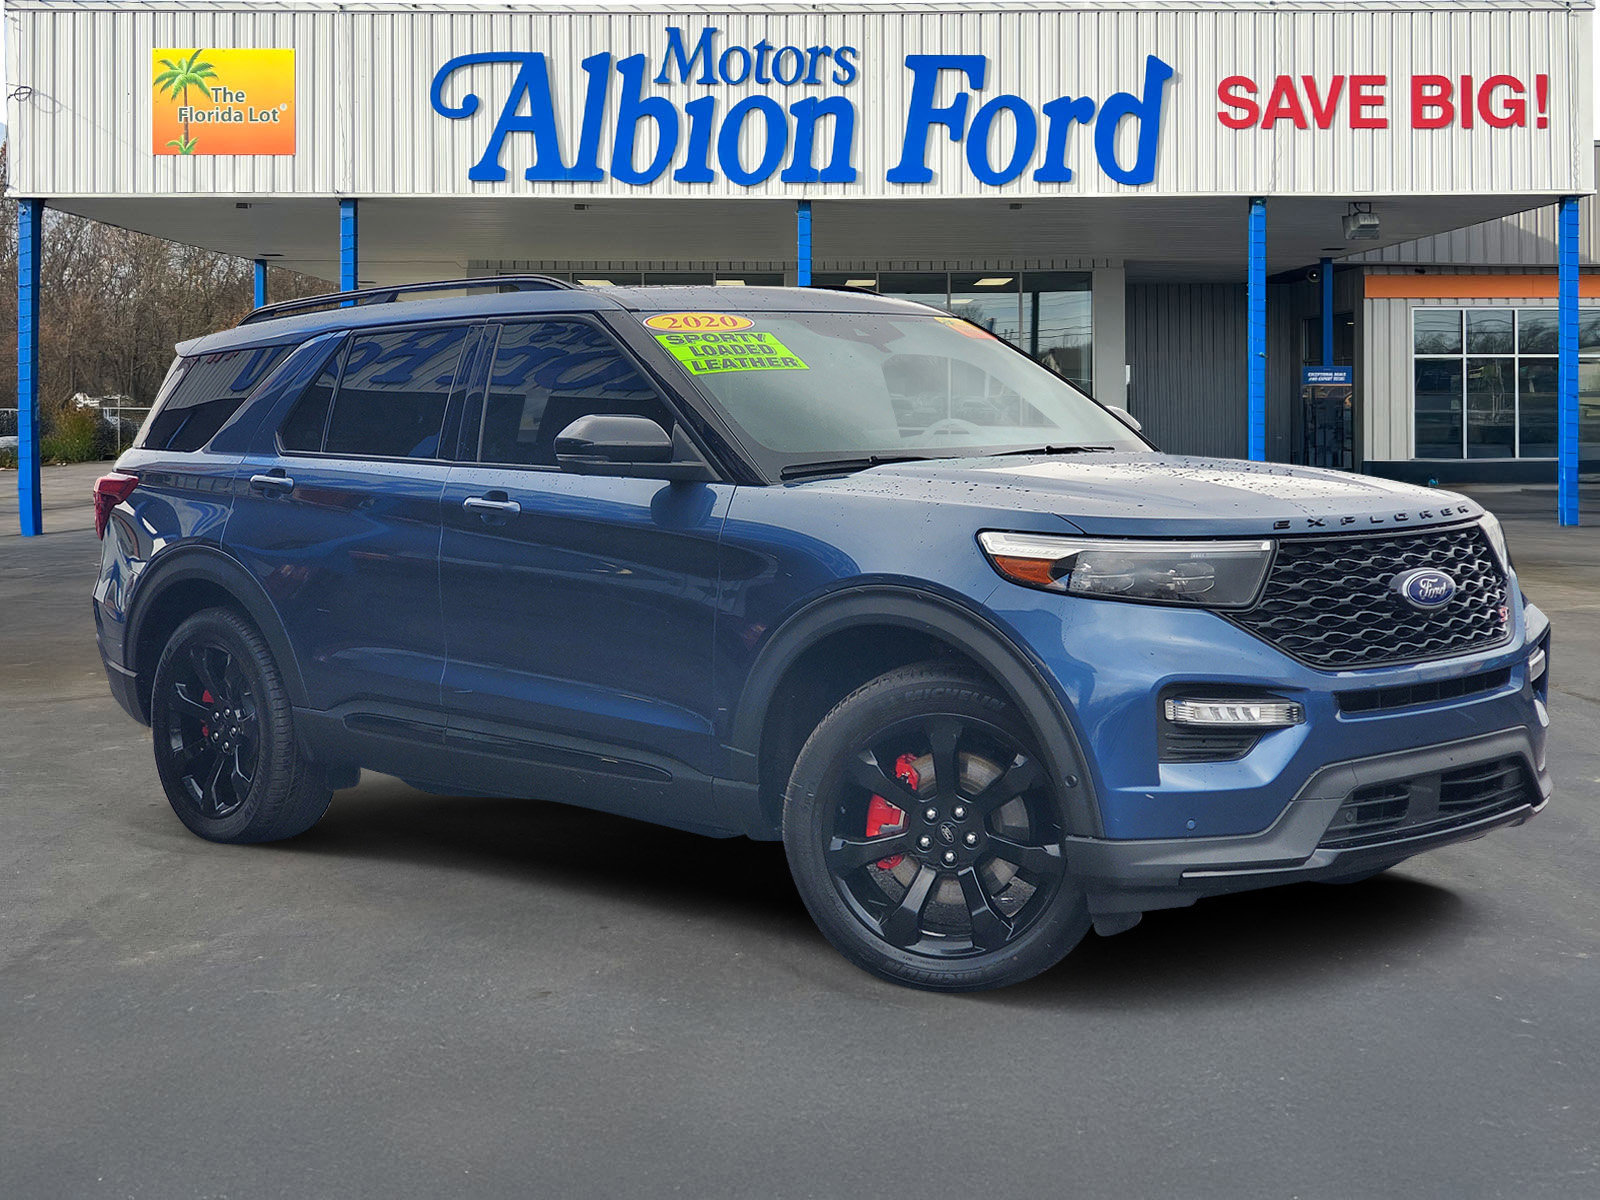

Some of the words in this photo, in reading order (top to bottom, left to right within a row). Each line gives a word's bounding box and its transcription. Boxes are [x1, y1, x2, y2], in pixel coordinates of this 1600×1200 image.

[654, 27, 857, 86] Motors
[211, 87, 246, 103] The
[1218, 75, 1388, 128] SAVE
[1412, 75, 1548, 128] BIG!
[178, 107, 244, 122] Florida
[249, 108, 279, 122] Lot
[430, 52, 857, 185] Albion
[886, 55, 1174, 185] Ford
[662, 315, 739, 329] 2020
[665, 333, 767, 345] SPORTY
[689, 344, 777, 357] LOADED
[691, 356, 800, 371] LEATHER
[1273, 505, 1470, 530] EXPLORER
[1419, 578, 1447, 600] Ford
